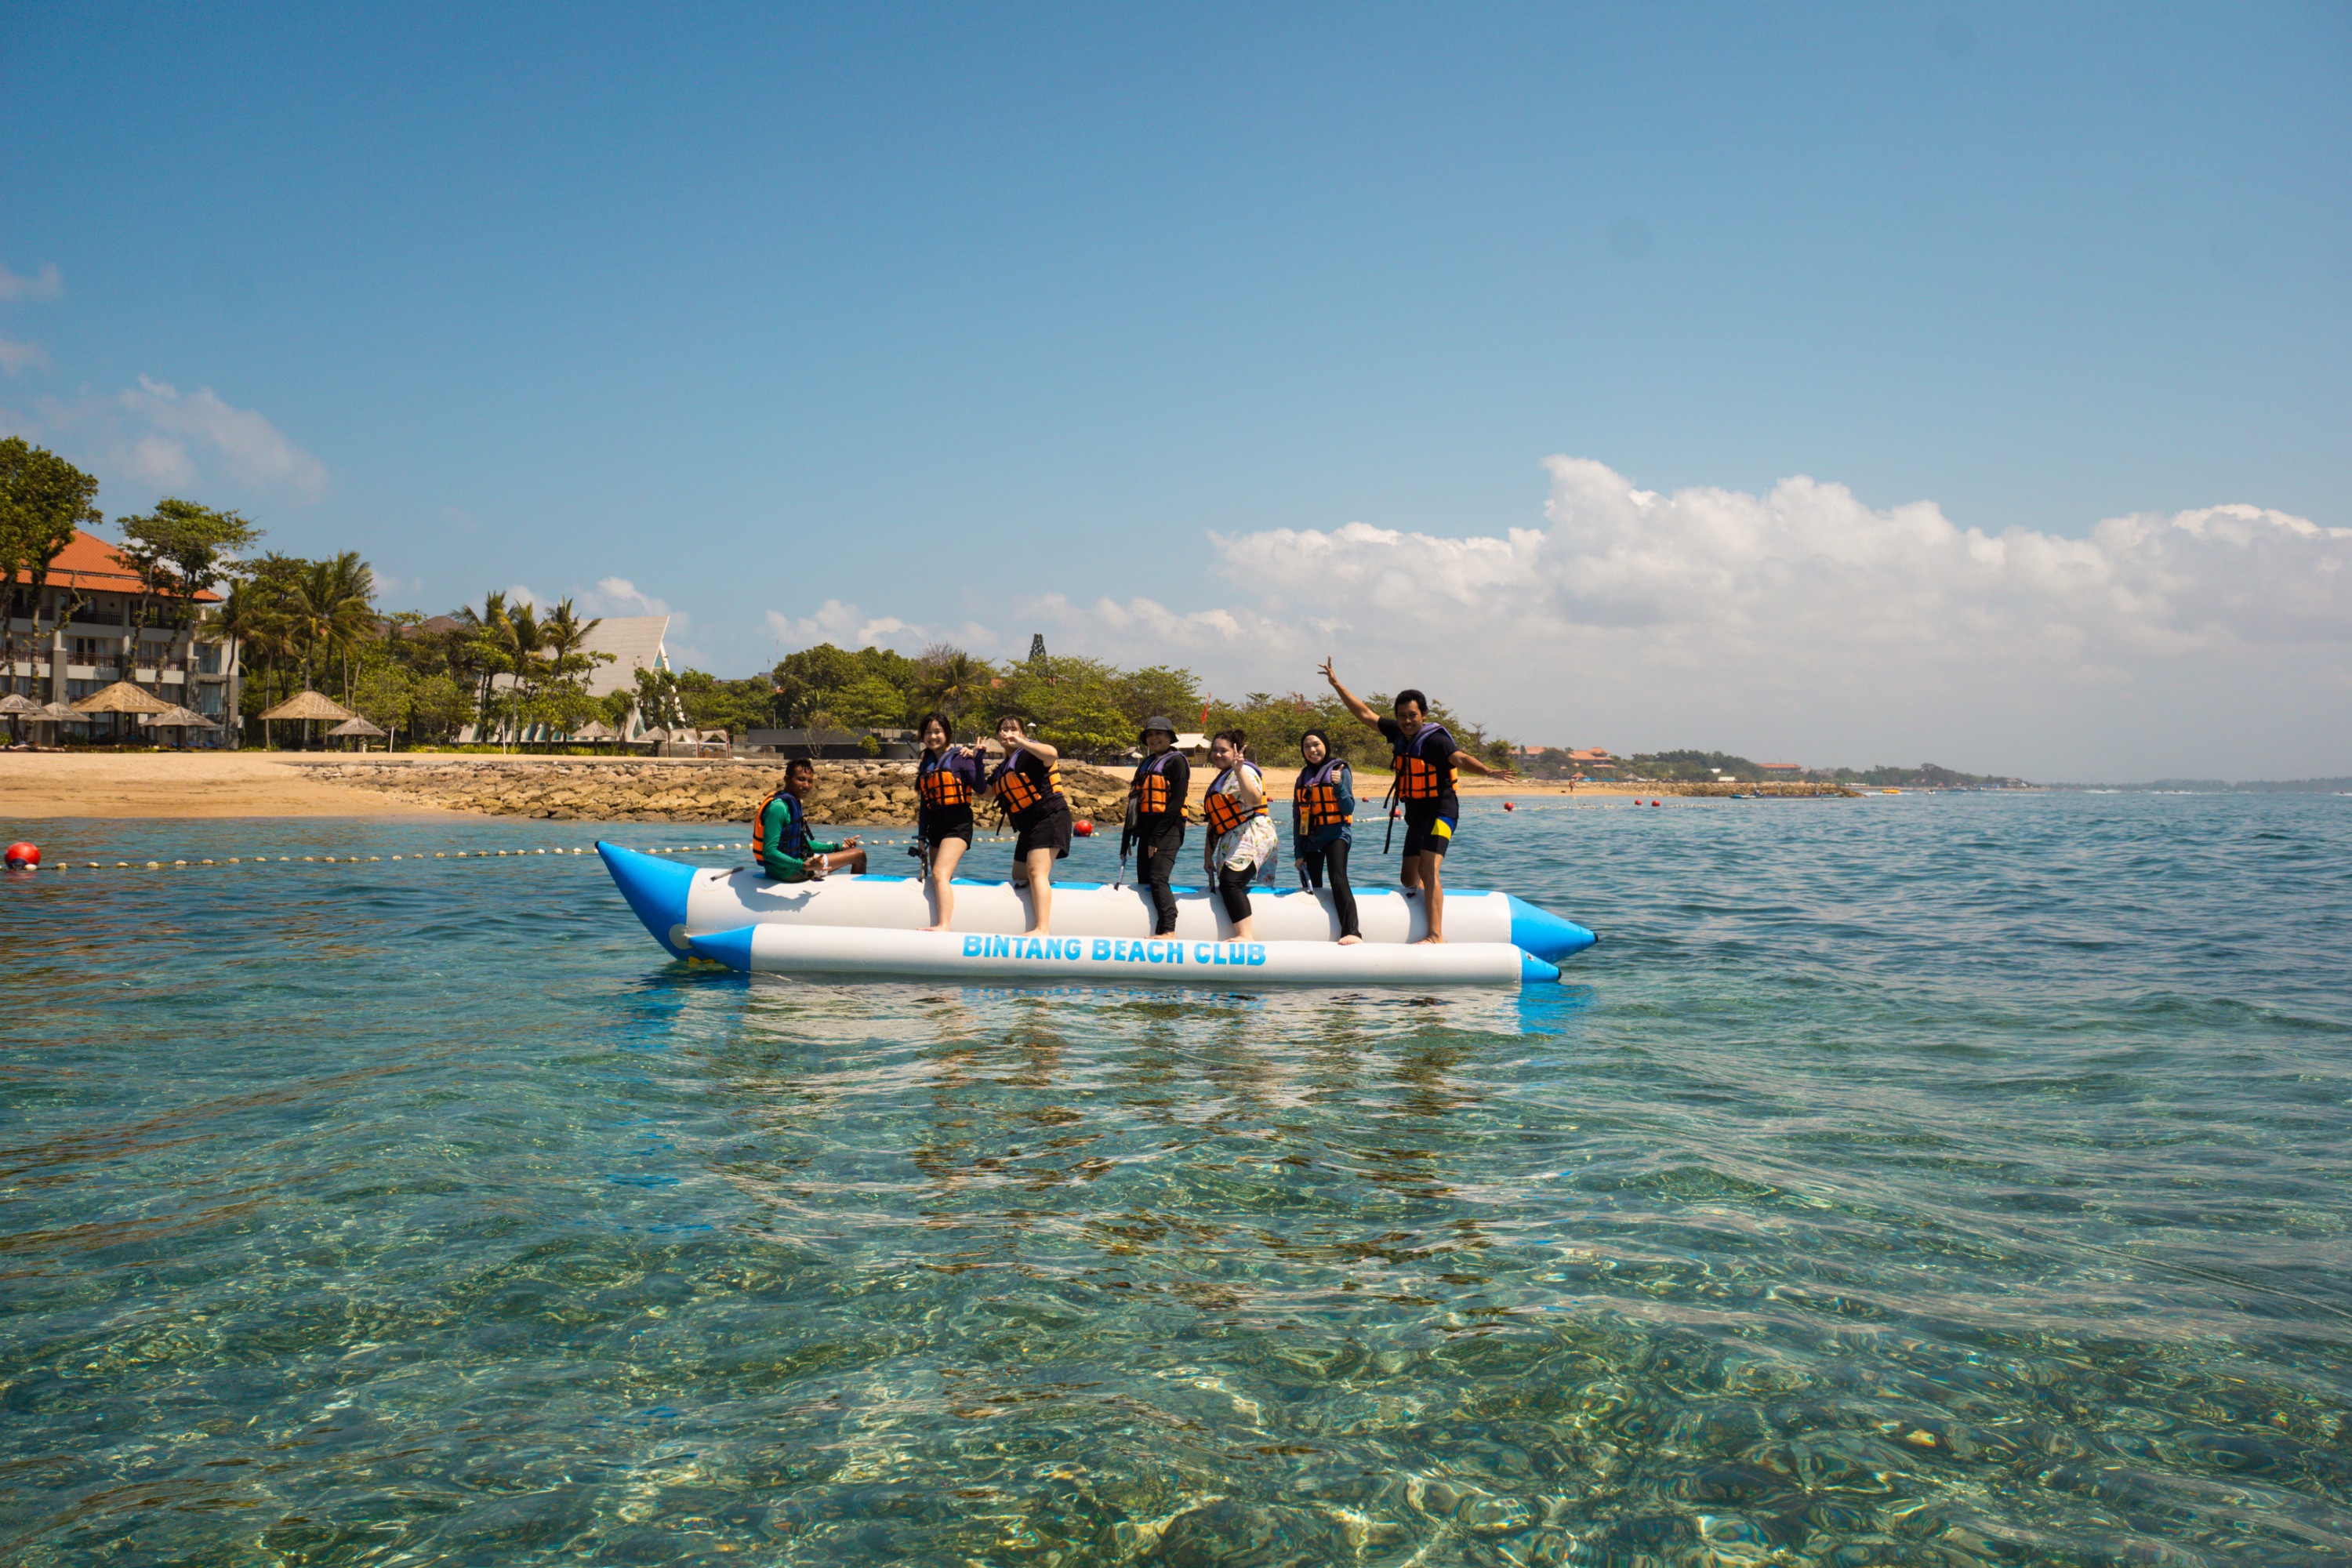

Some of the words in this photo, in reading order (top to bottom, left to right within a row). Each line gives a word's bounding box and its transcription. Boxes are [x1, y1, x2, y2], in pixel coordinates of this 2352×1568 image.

[963, 935, 1081, 960] BINTANG
[1091, 939, 1184, 964] BEACH
[1194, 943, 1266, 966] CLUB
